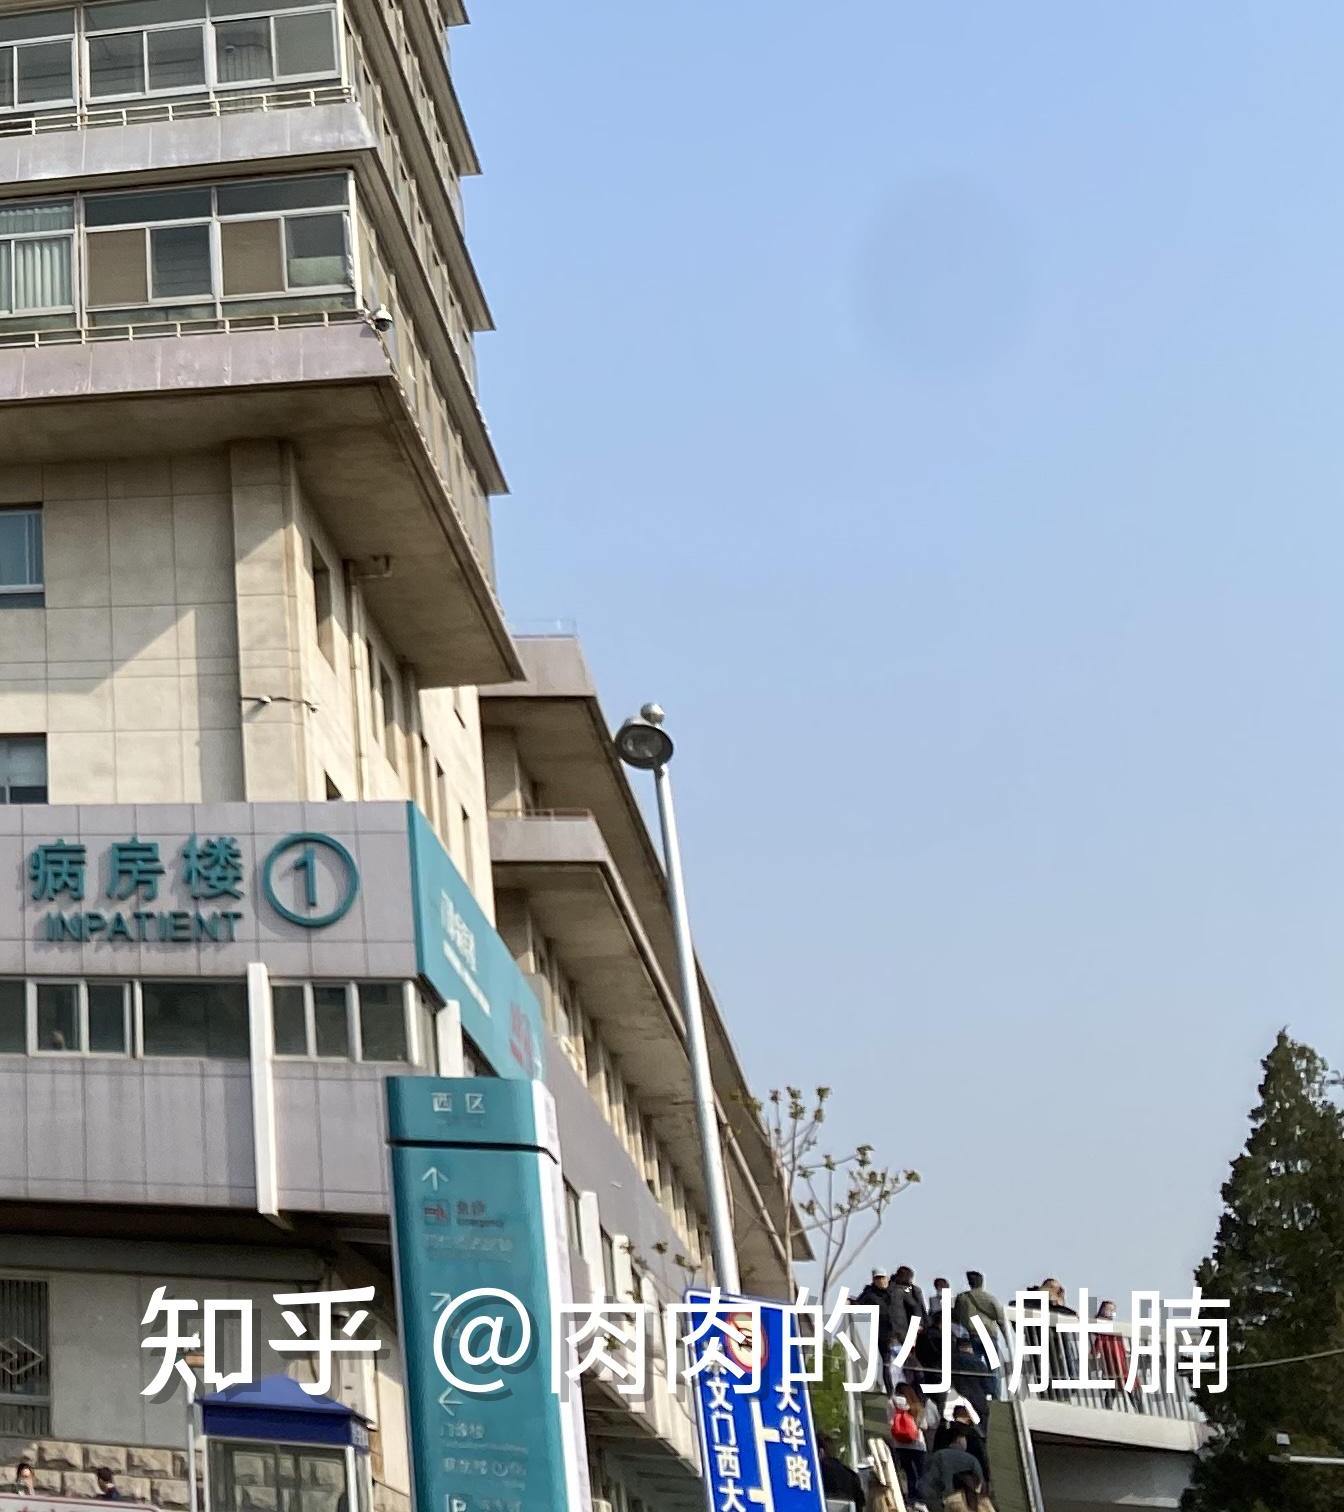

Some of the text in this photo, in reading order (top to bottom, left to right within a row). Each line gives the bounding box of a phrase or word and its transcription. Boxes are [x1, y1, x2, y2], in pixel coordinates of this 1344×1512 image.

[30, 834, 245, 901] 病房楼
[44, 911, 243, 942] INPATIENT
[432, 1092, 486, 1114] 西区
[774, 1380, 812, 1492] 大华路
